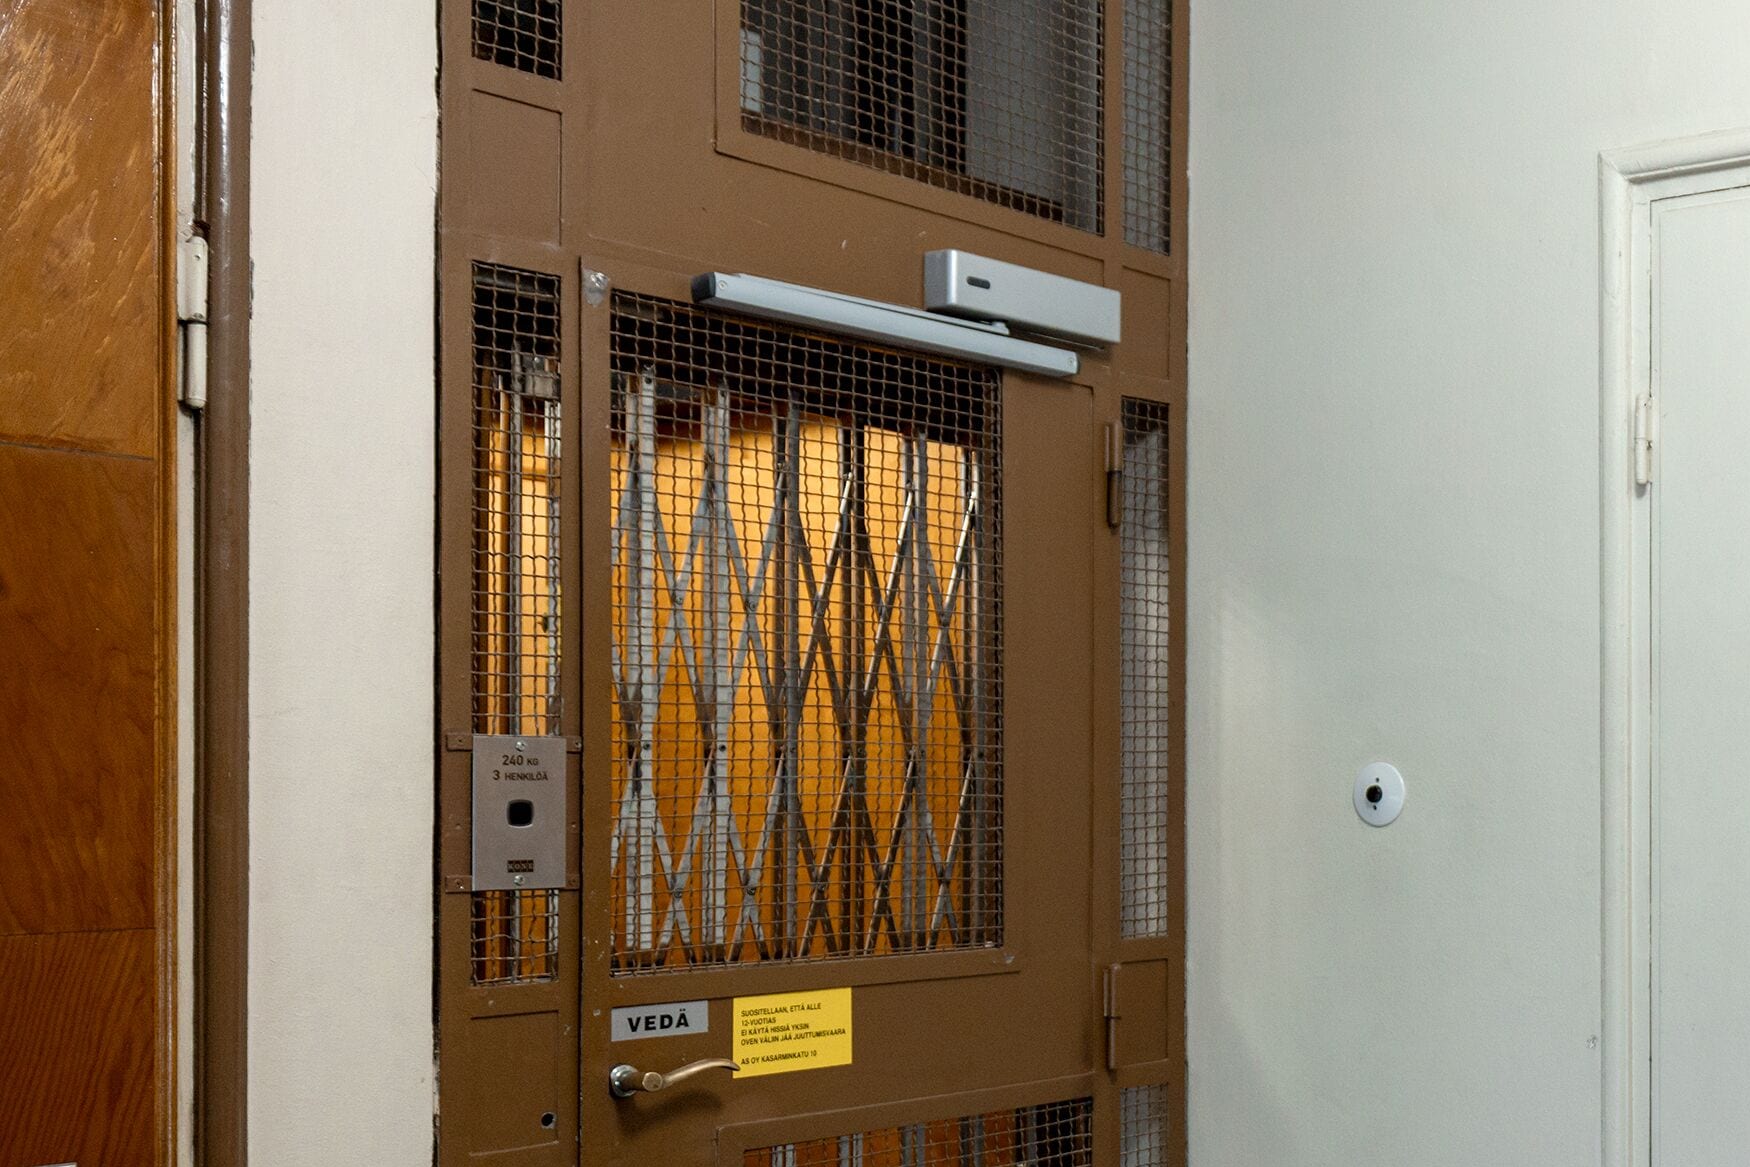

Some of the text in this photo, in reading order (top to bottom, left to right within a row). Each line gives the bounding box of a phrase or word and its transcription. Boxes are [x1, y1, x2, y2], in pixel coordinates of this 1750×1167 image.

[502, 754, 539, 766] 240 KG
[492, 769, 549, 781] 3 HENKILÖÄ
[789, 1002, 805, 1012] ETTÄ
[806, 1002, 822, 1010] ALLE
[628, 1008, 689, 1033] VEDÄ
[741, 1038, 759, 1046] OVEN
[751, 1056, 760, 1064] OY
[762, 1051, 809, 1062] KASARMINKATU
[810, 1049, 817, 1057] 10
